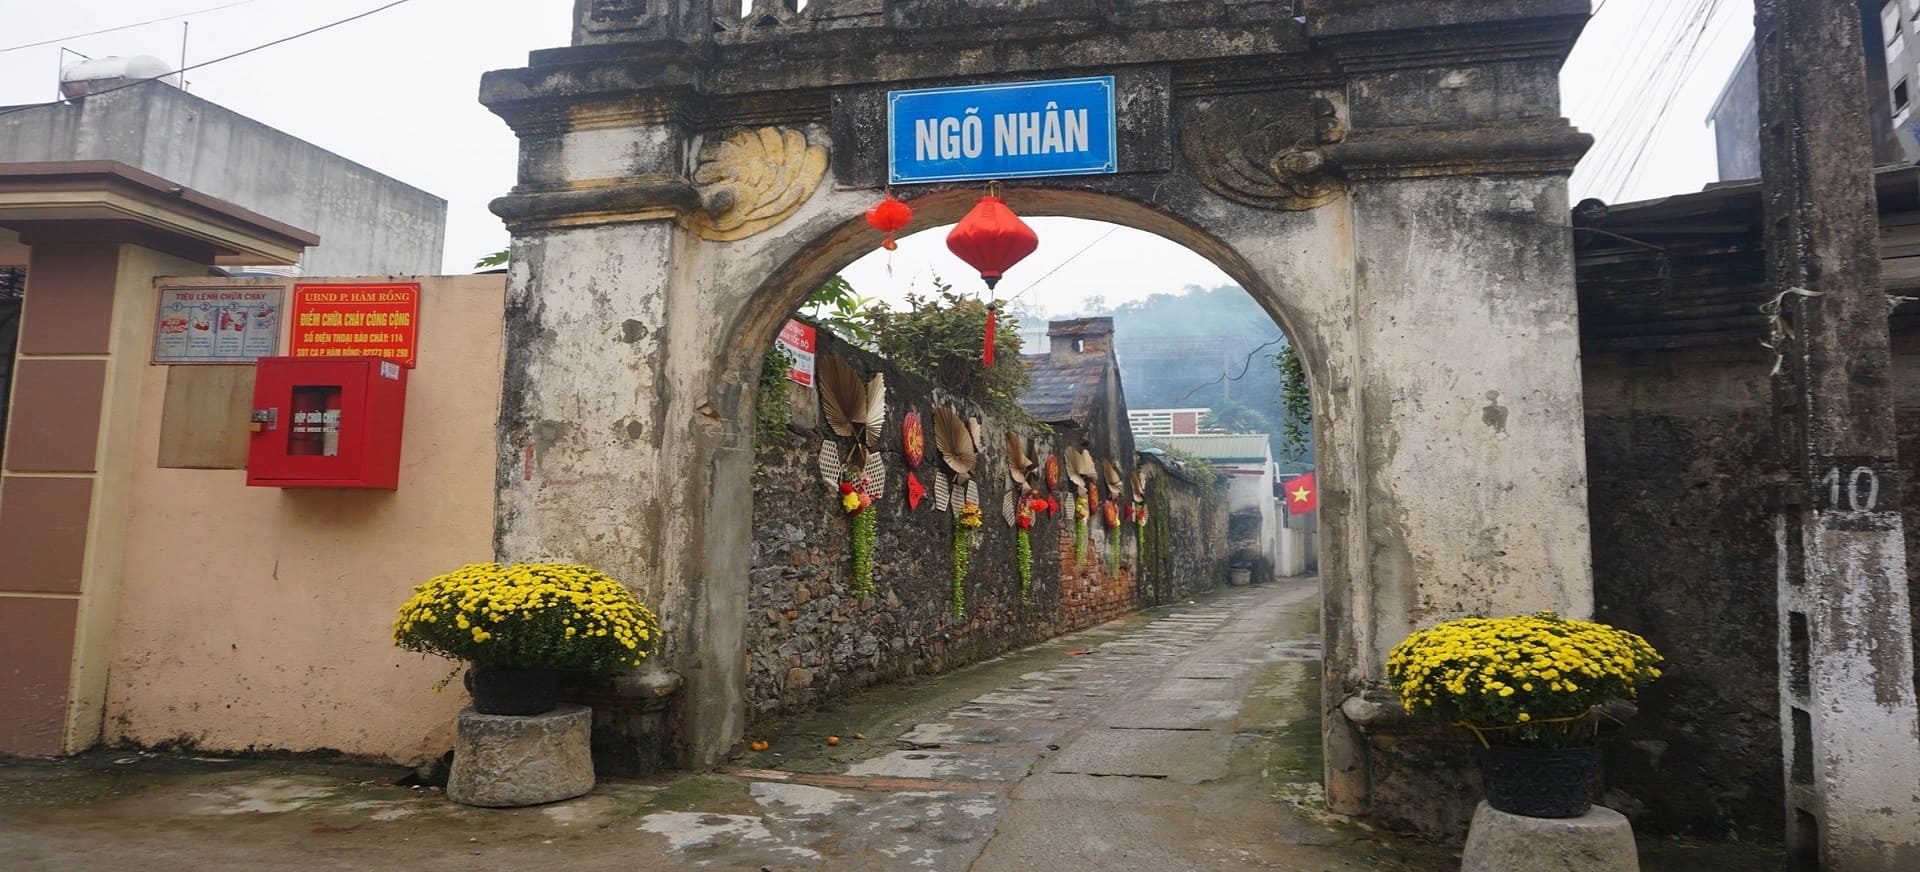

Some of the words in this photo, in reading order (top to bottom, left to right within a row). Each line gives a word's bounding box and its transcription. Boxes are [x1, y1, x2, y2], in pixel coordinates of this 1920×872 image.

[915, 106, 983, 161] NGÕ
[994, 101, 1089, 157] NHÂN
[305, 293, 337, 302] UBND
[340, 293, 349, 302] P.
[300, 308, 321, 327] ĐIỂM
[321, 310, 343, 327] CHỮA
[344, 310, 365, 327] CHÁY
[366, 310, 388, 327] CÔNG
[388, 310, 410, 329] CỘNG
[303, 330, 314, 343] SỐ
[314, 332, 331, 345] ĐIỆN
[333, 333, 353, 345] THOẠI
[354, 332, 368, 343] BÁO
[391, 333, 404, 343] 114
[1822, 466, 1879, 512] 10
